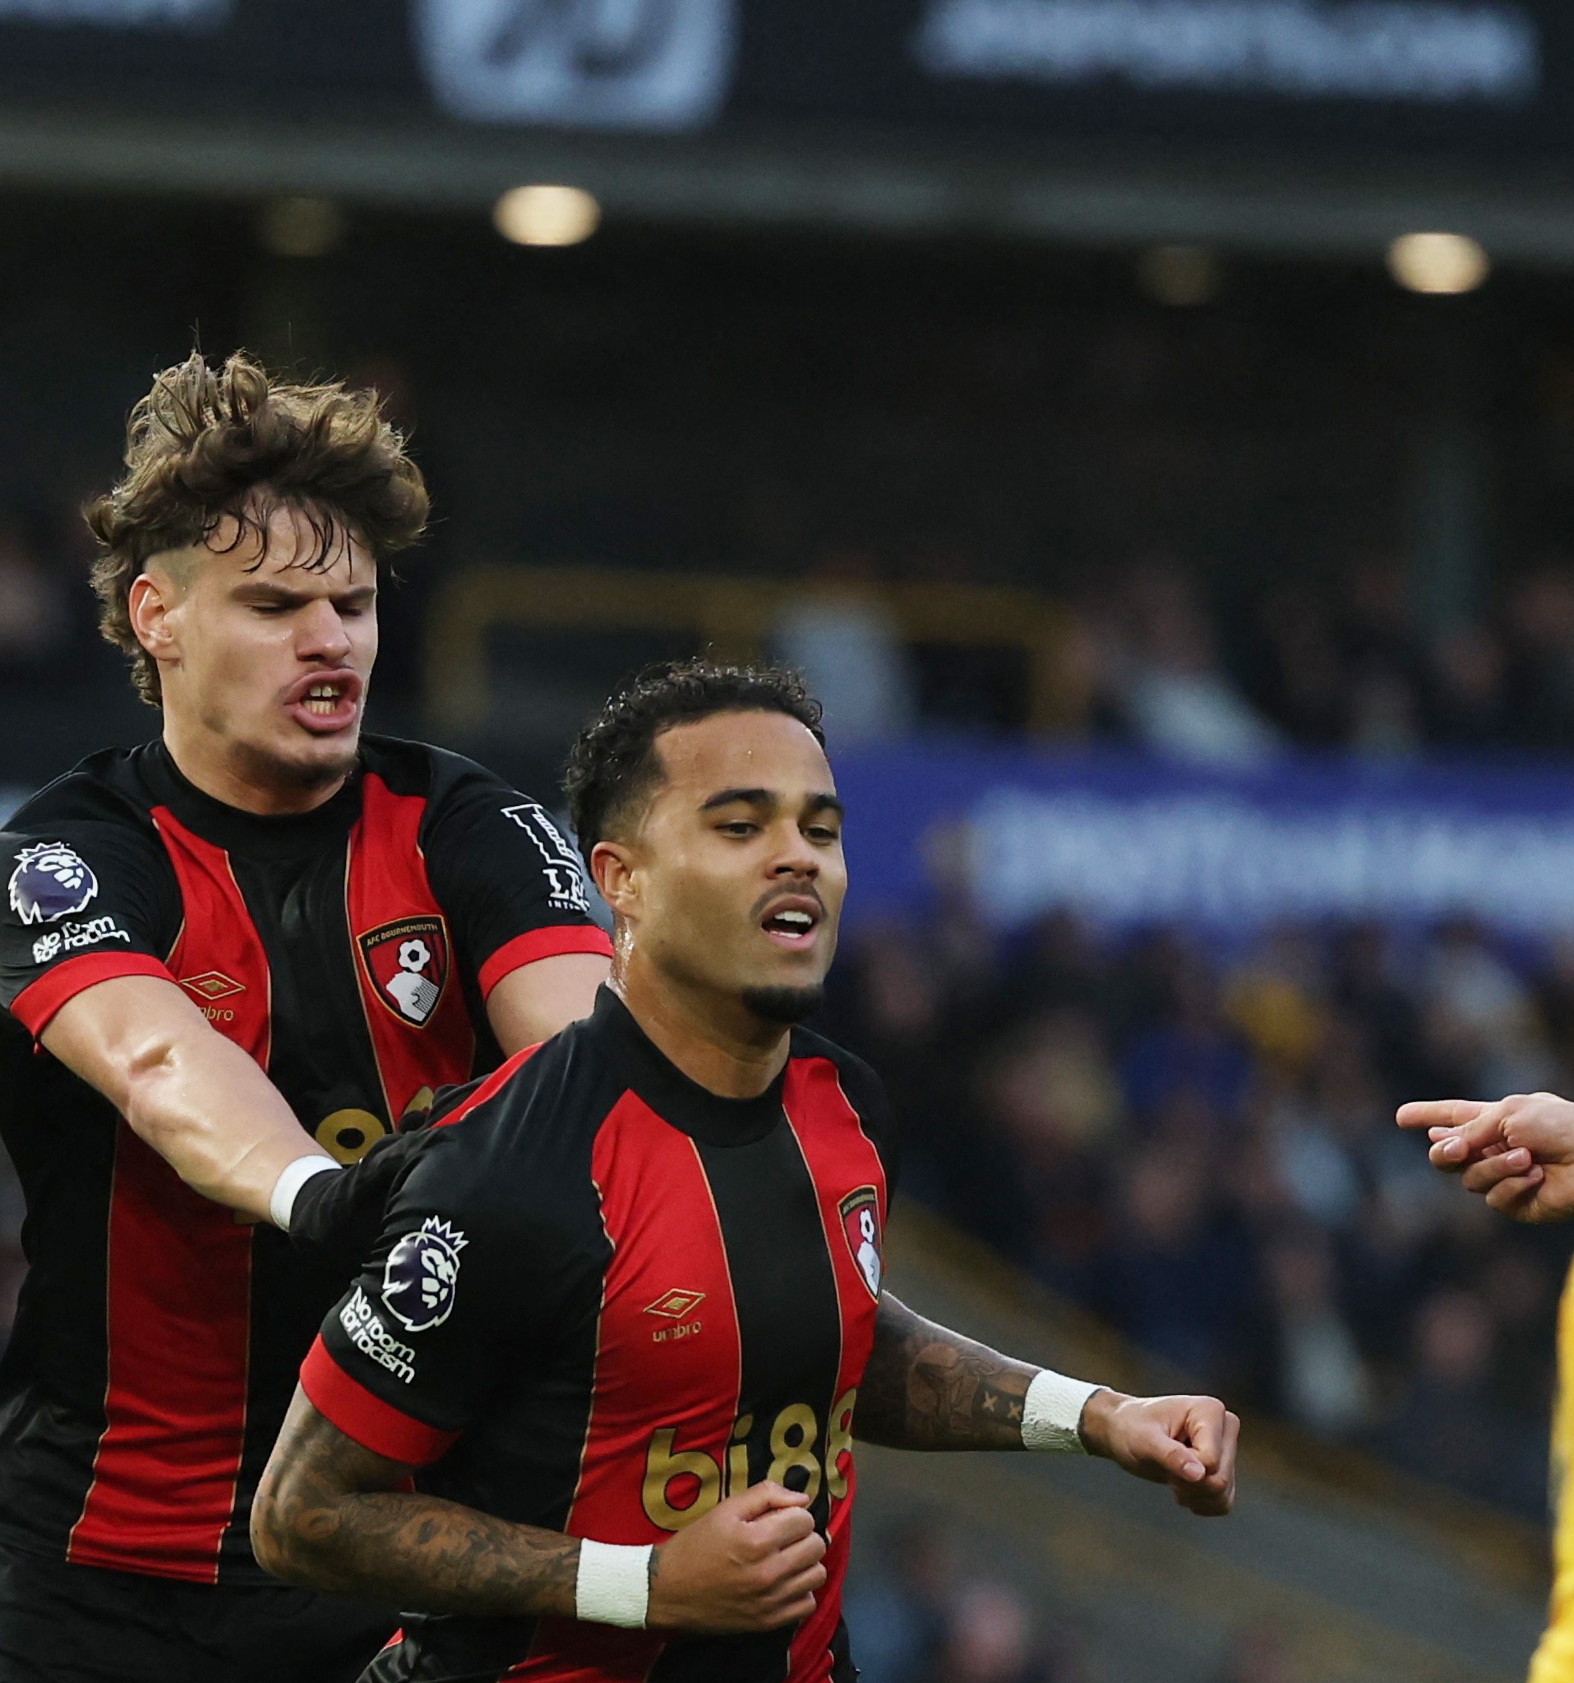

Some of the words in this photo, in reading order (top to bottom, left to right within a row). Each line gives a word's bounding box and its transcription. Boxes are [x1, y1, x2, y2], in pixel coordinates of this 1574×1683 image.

[33, 931, 61, 952] No
[339, 1302, 362, 1333] for
[351, 1330, 416, 1384] racism
[349, 1285, 372, 1322] No
[366, 1315, 416, 1364] room
